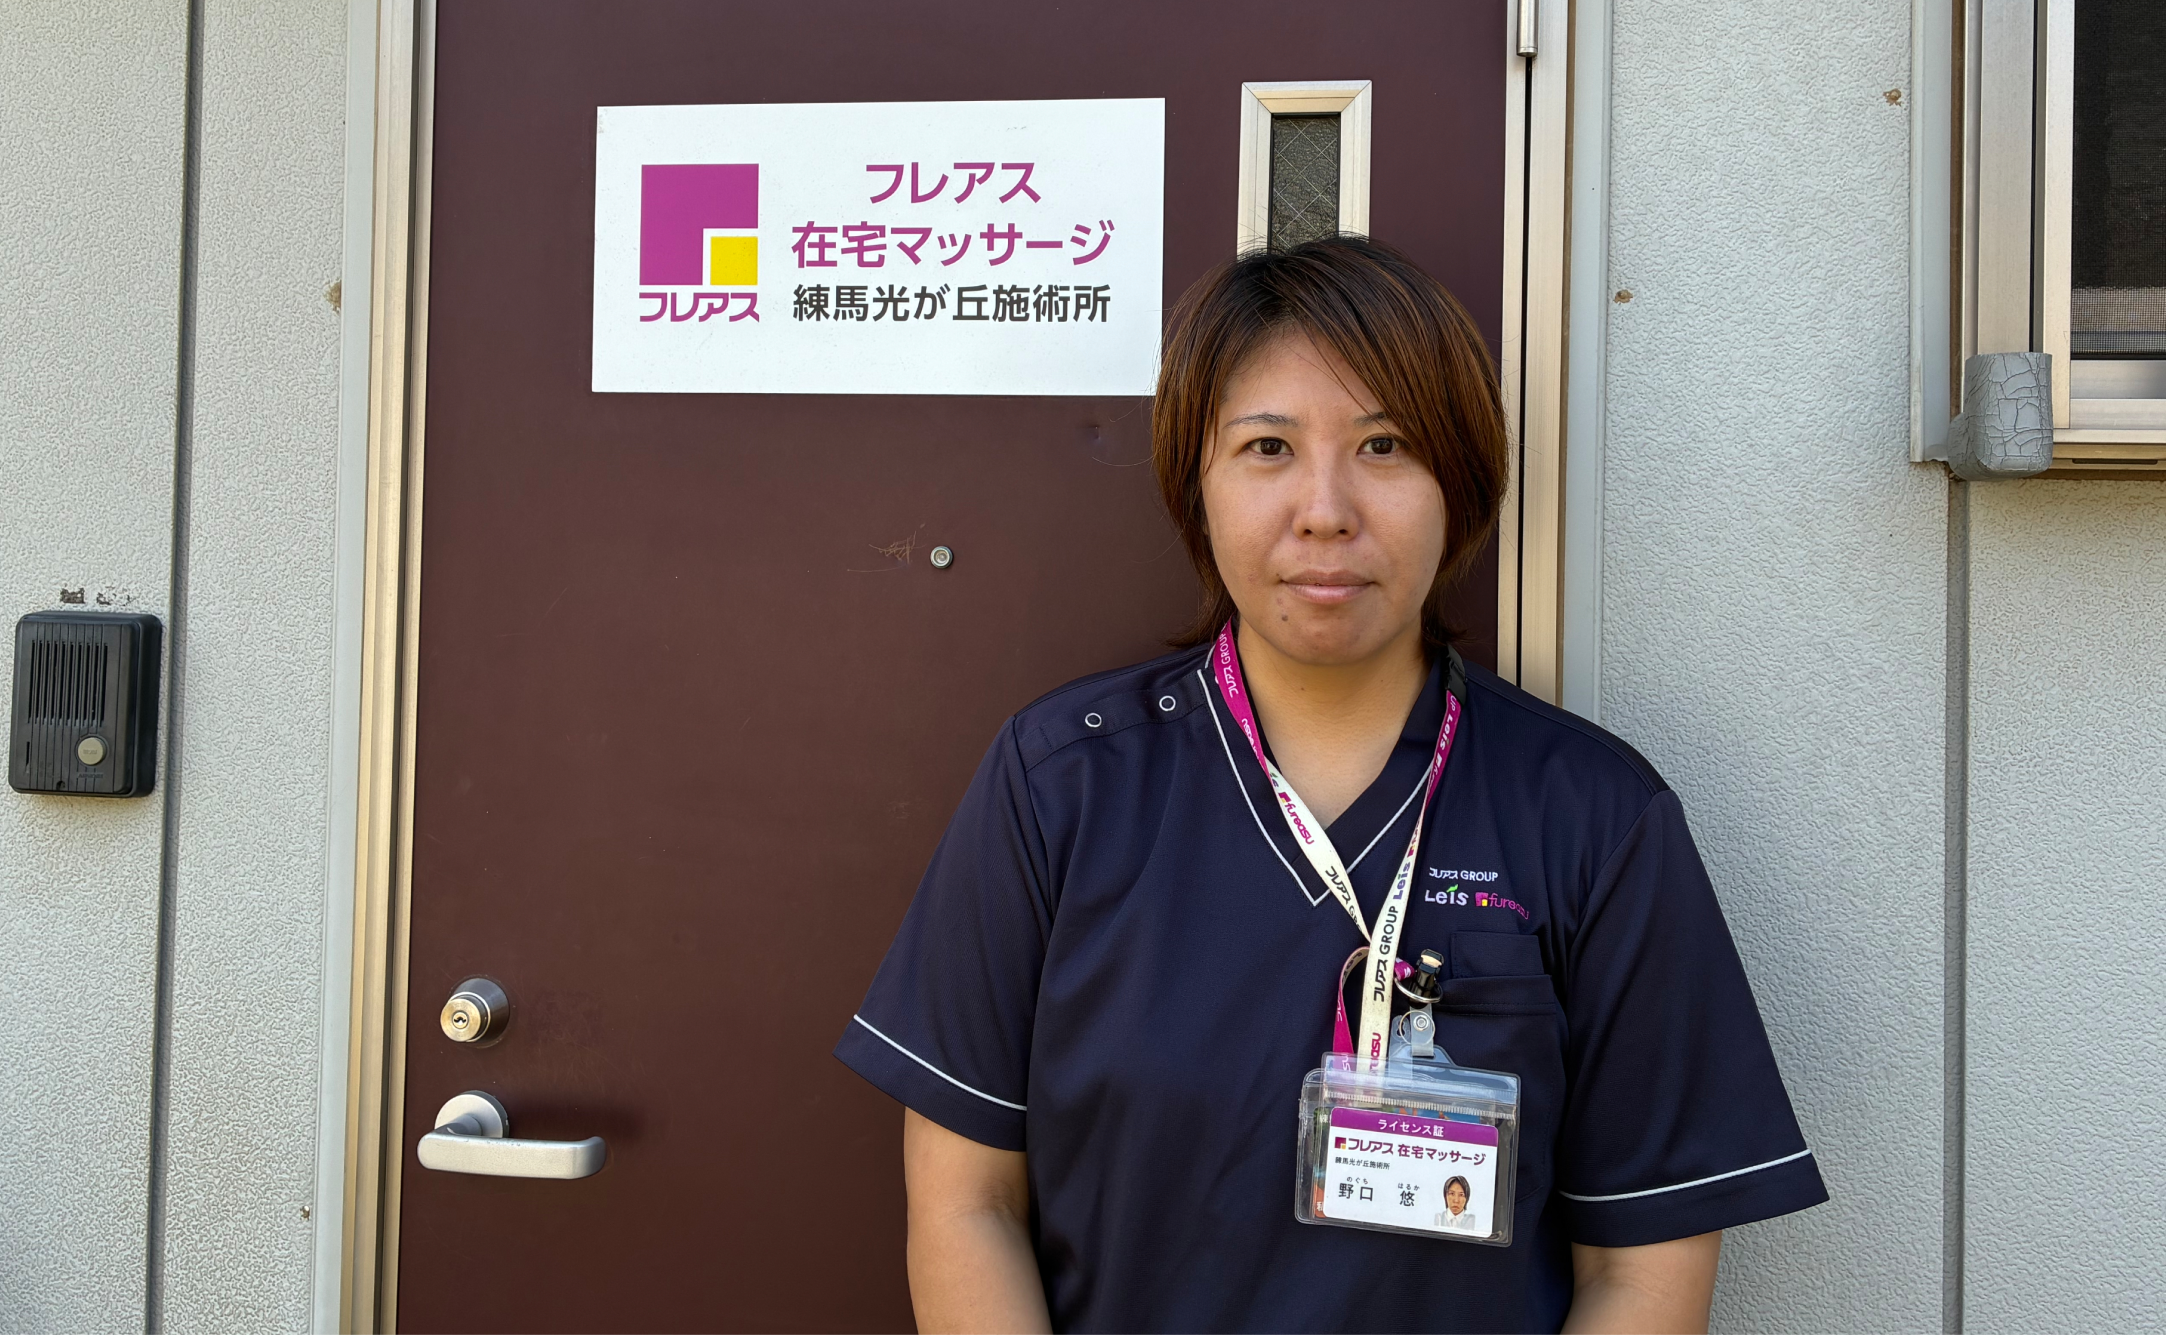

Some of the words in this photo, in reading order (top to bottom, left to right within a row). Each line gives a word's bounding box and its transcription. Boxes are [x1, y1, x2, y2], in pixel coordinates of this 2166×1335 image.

[866, 162, 1041, 204] フレアス
[792, 219, 1115, 269] 在宅マッサージ
[640, 292, 760, 323] フレアス
[793, 284, 1111, 323] 練馬光が丘施術所
[1284, 802, 1315, 845] fureasu
[1393, 861, 1411, 900] Leis
[1429, 867, 1459, 880] フレアス
[1460, 870, 1499, 882] GROUP
[1424, 884, 1469, 906] Leis
[1379, 905, 1399, 955] GROUP
[1373, 958, 1388, 1002] フレアス
[1377, 1119, 1444, 1138] ライセンス証
[1335, 1156, 1390, 1170] 練馬光が丘施術所
[1348, 1138, 1394, 1155] フレアス
[1397, 1144, 1487, 1166] 在宅マッサージ
[1338, 1182, 1374, 1201] 野口
[1399, 1190, 1415, 1207] 悠
[1346, 1176, 1369, 1185] のぐち
[1397, 1182, 1420, 1192] はるか
